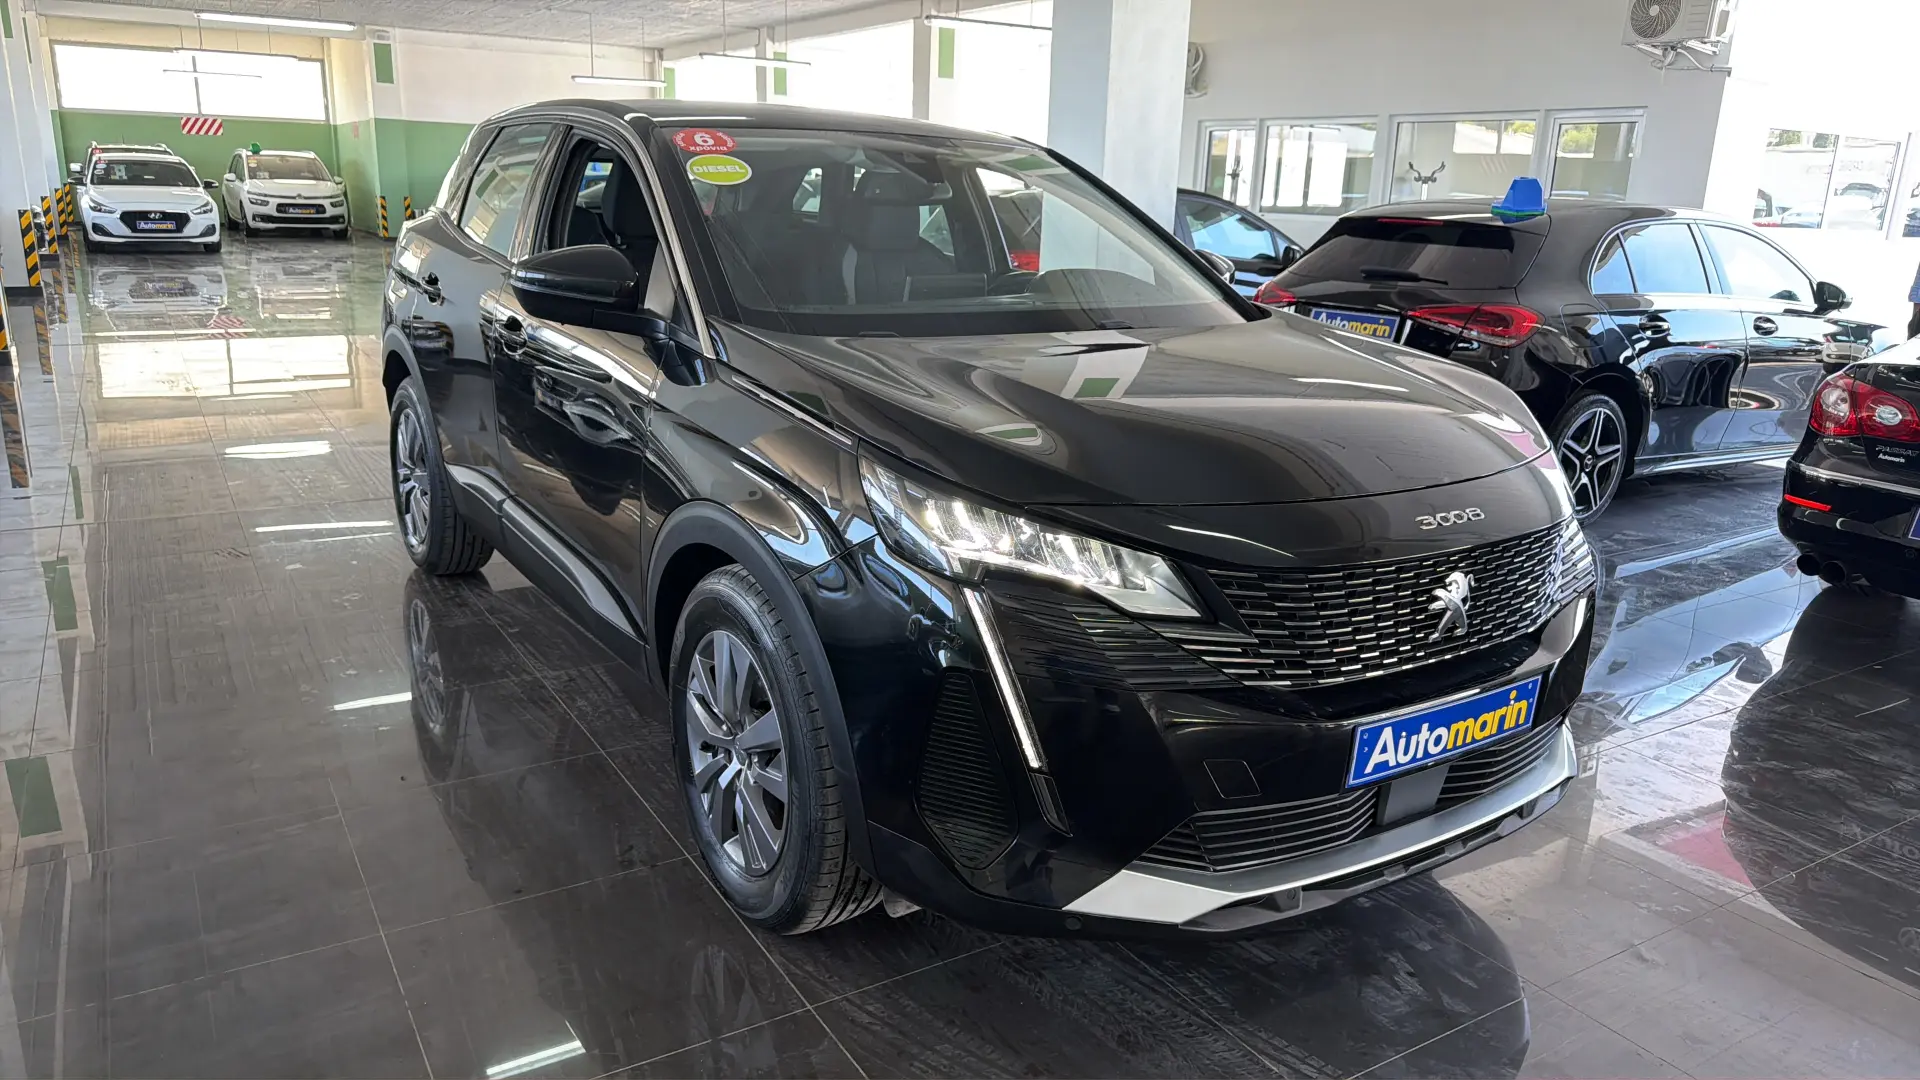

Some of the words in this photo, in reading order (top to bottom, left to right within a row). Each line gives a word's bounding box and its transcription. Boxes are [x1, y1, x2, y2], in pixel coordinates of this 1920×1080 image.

[693, 133, 715, 146] 6
[692, 165, 746, 173] DIESEL
[139, 221, 174, 229] Automarin
[1318, 312, 1391, 337] Automarin
[1877, 453, 1906, 463] Automarin
[1415, 507, 1485, 529] 3008
[1363, 690, 1529, 774] Automarin
